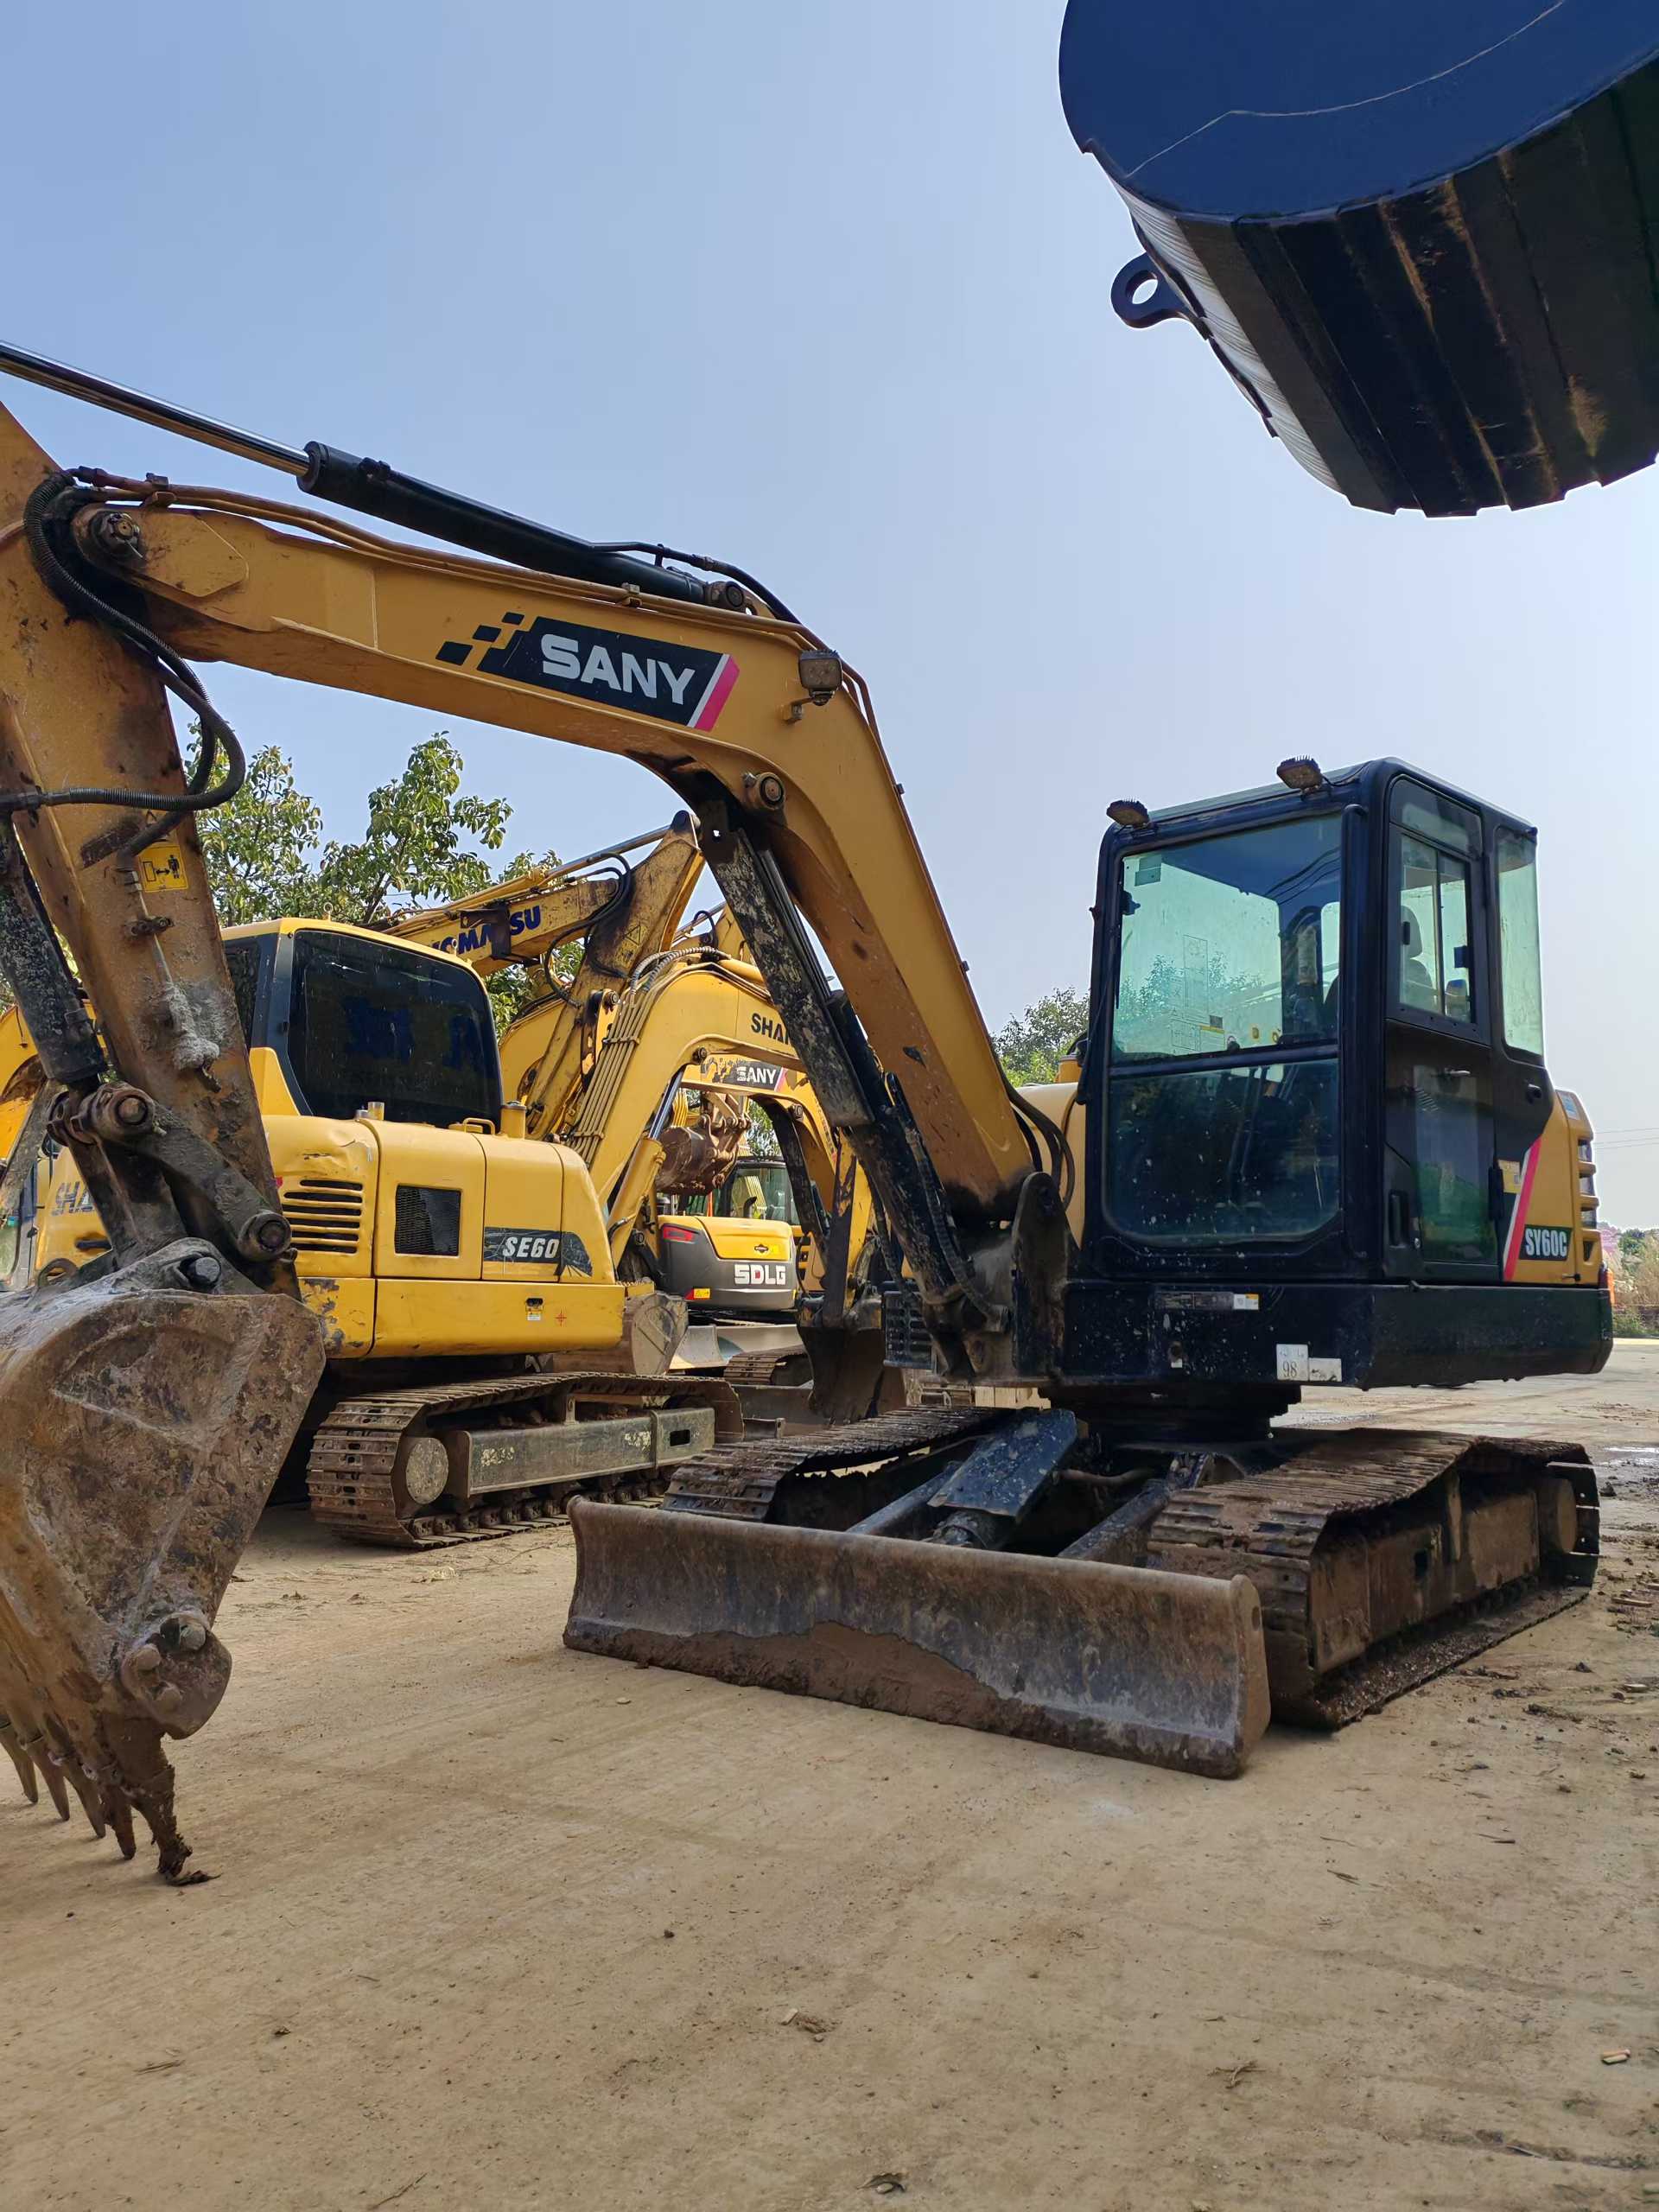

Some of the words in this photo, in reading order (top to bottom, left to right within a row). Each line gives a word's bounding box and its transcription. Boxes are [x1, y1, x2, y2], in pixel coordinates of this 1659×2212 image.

[541, 633, 696, 705] SANY
[432, 905, 542, 955] OMASU
[751, 1012, 790, 1046] SHA
[736, 1065, 777, 1084] SANY
[502, 1236, 560, 1259] SE60
[1525, 1228, 1567, 1257] SY60C
[734, 1263, 786, 1285] SDLG
